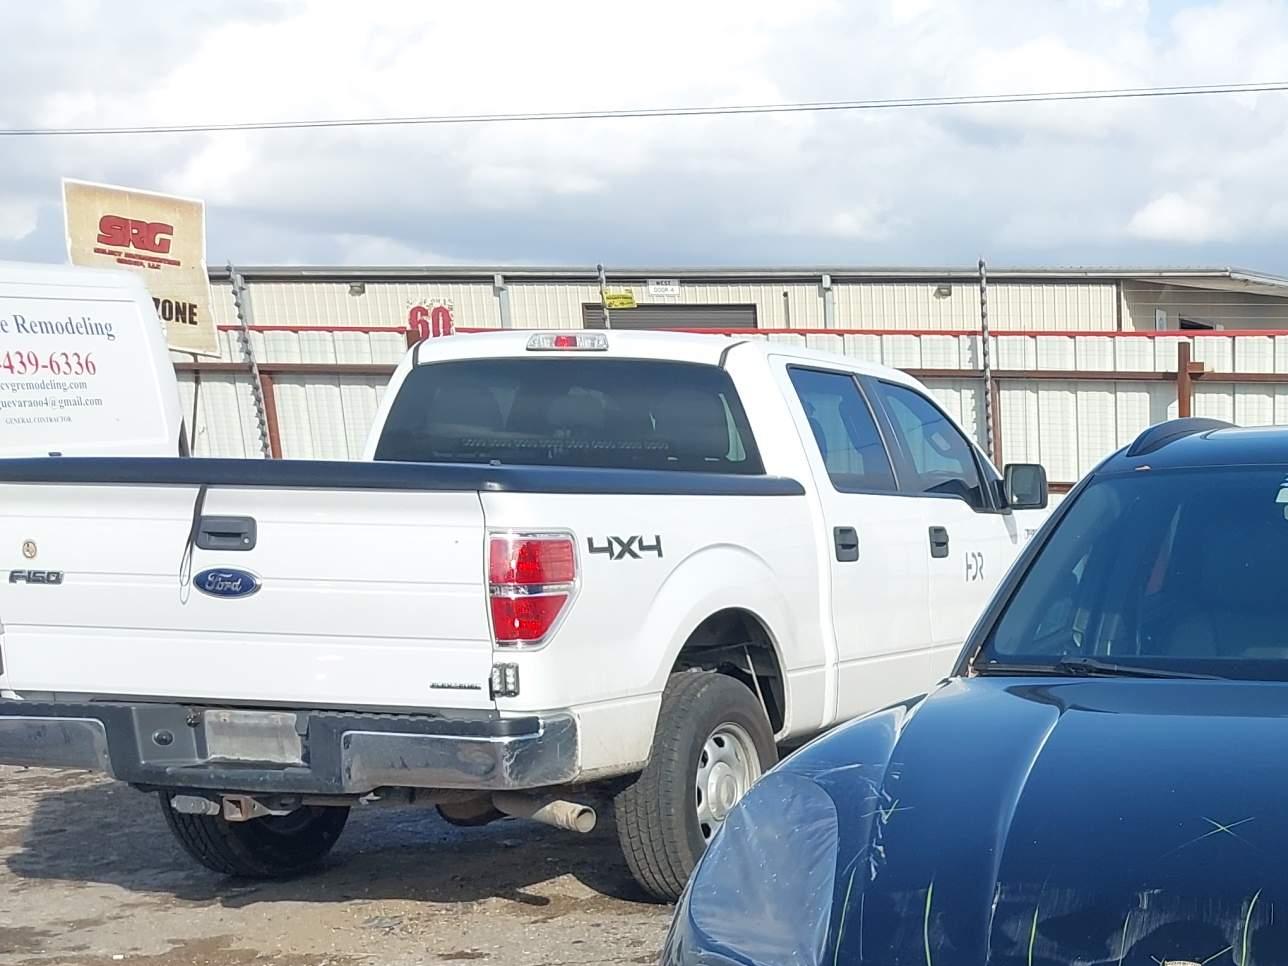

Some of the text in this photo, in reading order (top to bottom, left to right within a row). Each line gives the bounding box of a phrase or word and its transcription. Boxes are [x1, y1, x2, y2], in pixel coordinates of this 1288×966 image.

[97, 215, 174, 254] SRG
[12, 314, 116, 341] Remodeling
[205, 572, 242, 591] Ford
